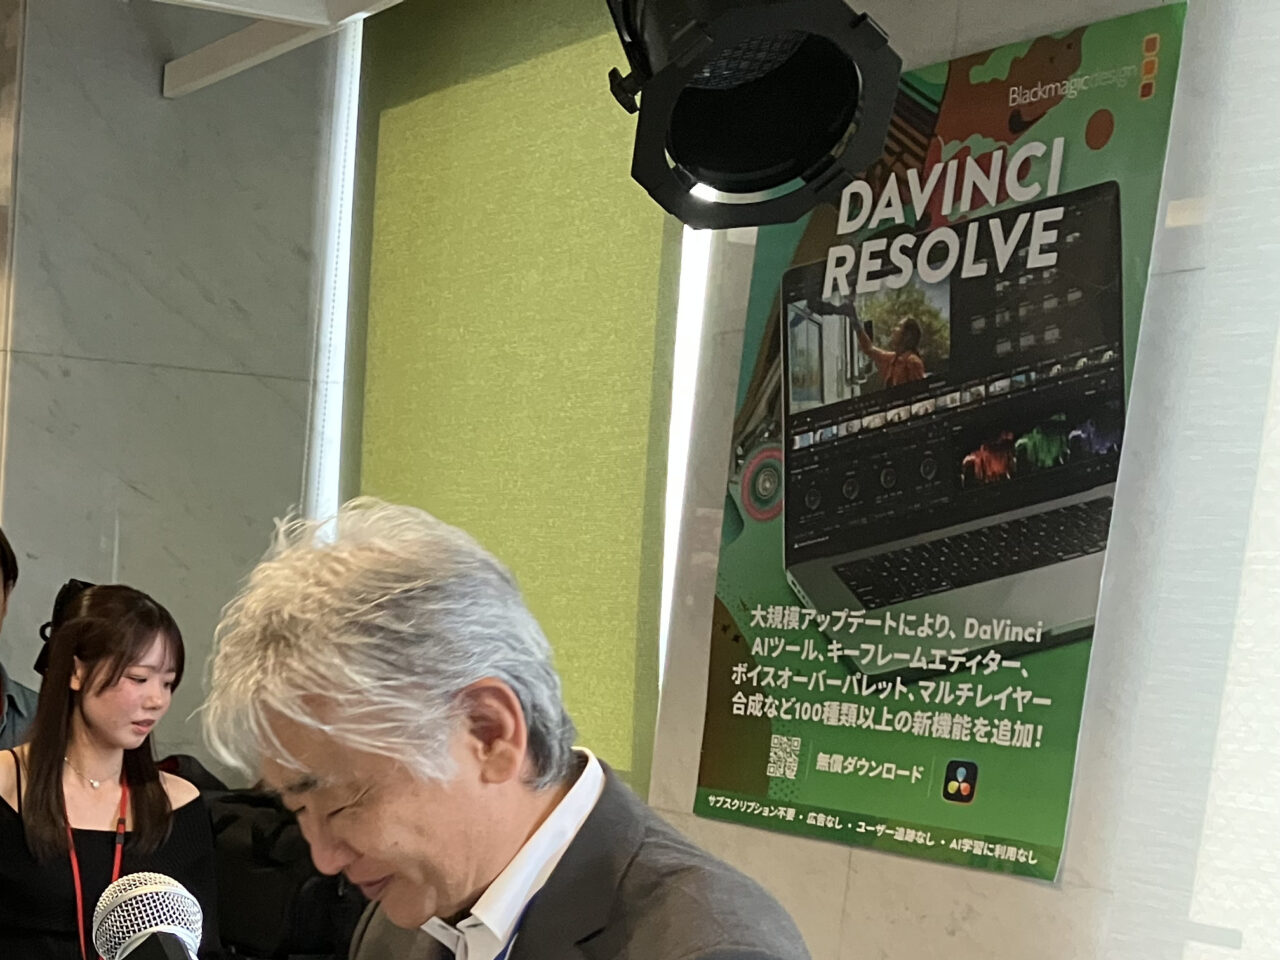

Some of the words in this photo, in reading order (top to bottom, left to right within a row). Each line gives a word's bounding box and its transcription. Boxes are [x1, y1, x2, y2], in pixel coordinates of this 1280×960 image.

[836, 137, 1065, 236] DAVINCI
[822, 206, 1065, 301] RESOLVE
[750, 604, 956, 639] 大規模アップデートにより、
[964, 617, 1042, 643] DaVinci
[751, 636, 1028, 678] AIツール、キーフレームエディター、
[731, 663, 1051, 712] ボイスオーバーパレット、マルチレイヤー
